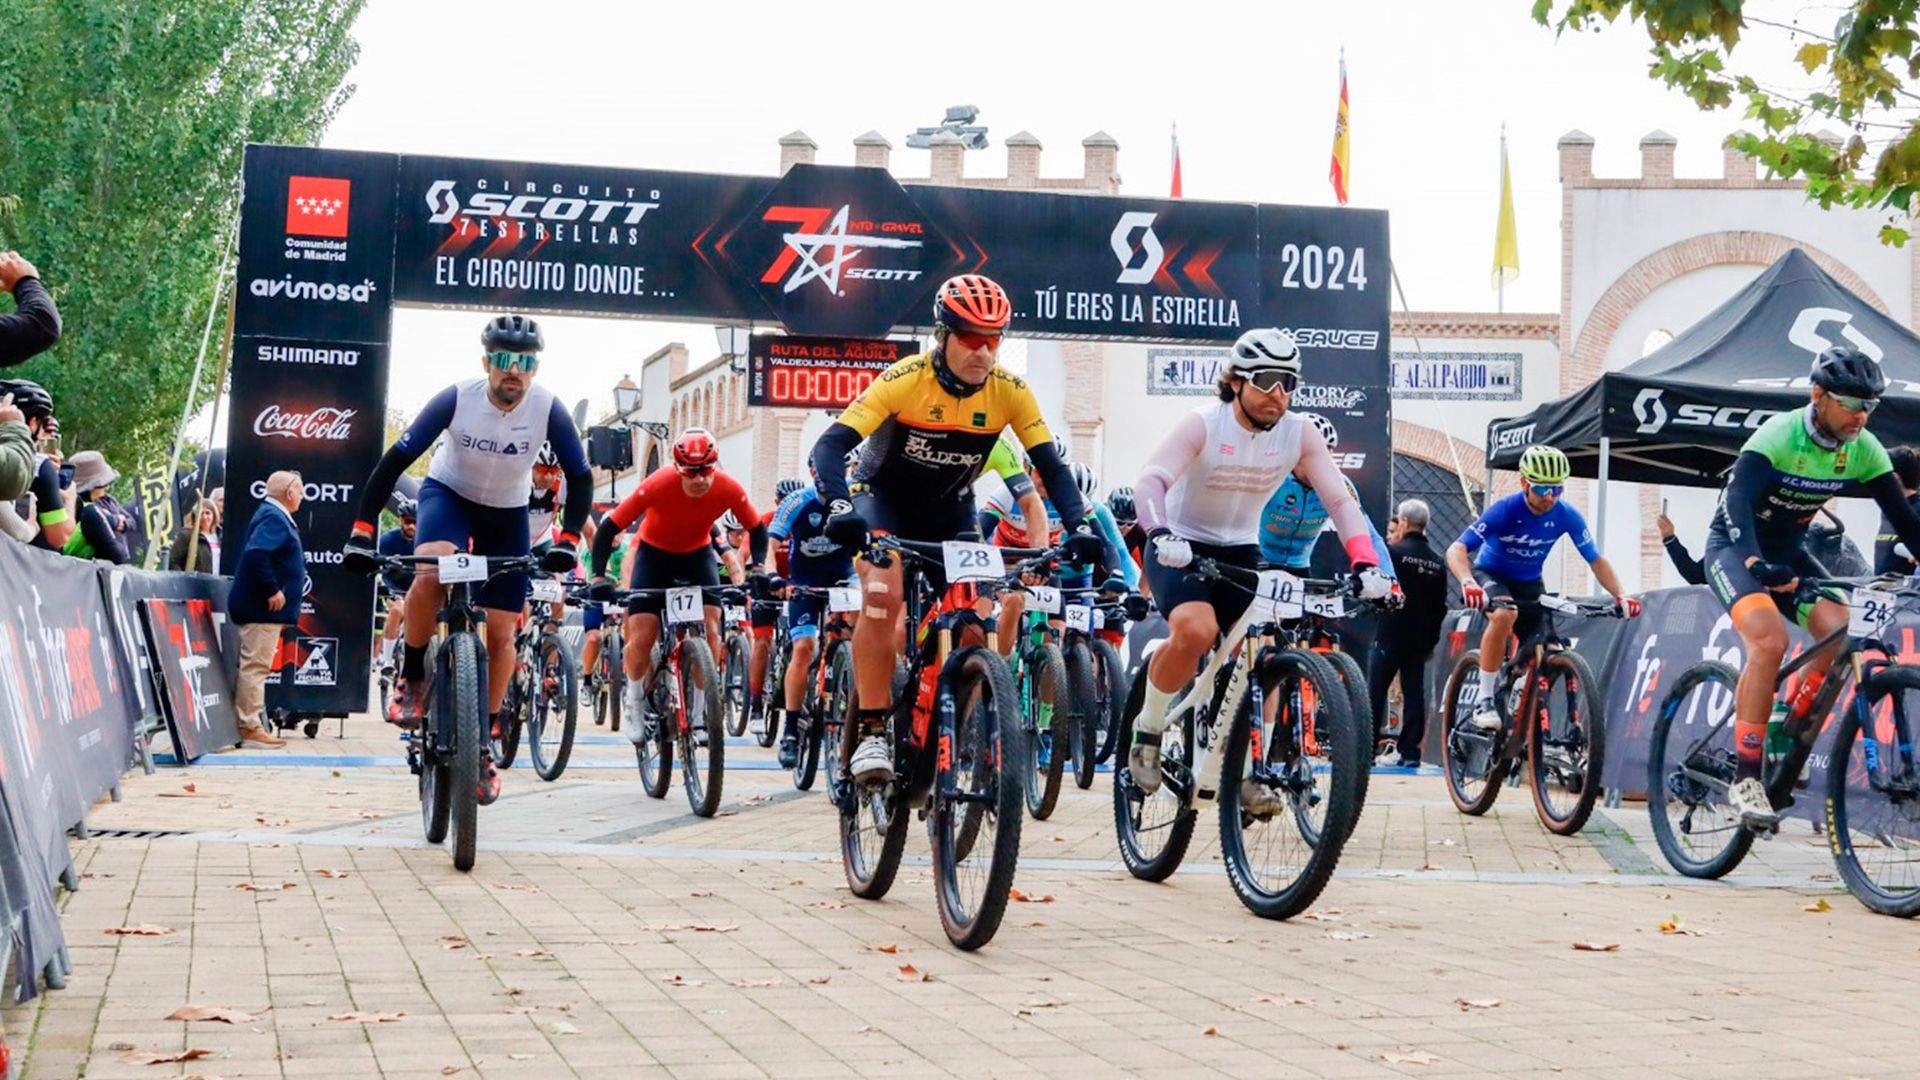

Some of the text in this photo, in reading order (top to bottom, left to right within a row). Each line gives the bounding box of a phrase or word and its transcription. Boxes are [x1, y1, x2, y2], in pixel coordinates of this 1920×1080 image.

[477, 179, 660, 199] CIRCUITO
[463, 195, 660, 224] SCOTT
[286, 237, 347, 251] Comunidad
[285, 250, 347, 262] de Madrid
[435, 256, 459, 287] EL
[466, 258, 565, 292] CIRCUITO
[574, 263, 645, 296] DONDE
[844, 268, 923, 280] SCOTT
[1282, 243, 1368, 292] 2024
[250, 275, 373, 303] avimosa
[1035, 285, 1058, 319] TÚ
[1066, 292, 1114, 322] ERES
[1122, 296, 1144, 323] LA
[1152, 297, 1240, 327] ESTRELLA
[257, 345, 359, 367] SHIMANO
[771, 345, 809, 357] RUTA
[812, 346, 841, 358] DEL
[1404, 363, 1486, 389] ALALPARDO
[1294, 386, 1348, 399] CTORY
[253, 405, 357, 440] Coca-Cola
[1671, 403, 1787, 428] SCO
[1498, 423, 1538, 449] SCOTT
[249, 480, 354, 503] GORT
[457, 556, 470, 569] 9
[957, 549, 991, 569] 28
[1269, 578, 1294, 604] 10
[674, 594, 694, 612] 17
[1313, 602, 1335, 616] 25
[1863, 600, 1889, 623] 24
[1068, 609, 1084, 621] 32
